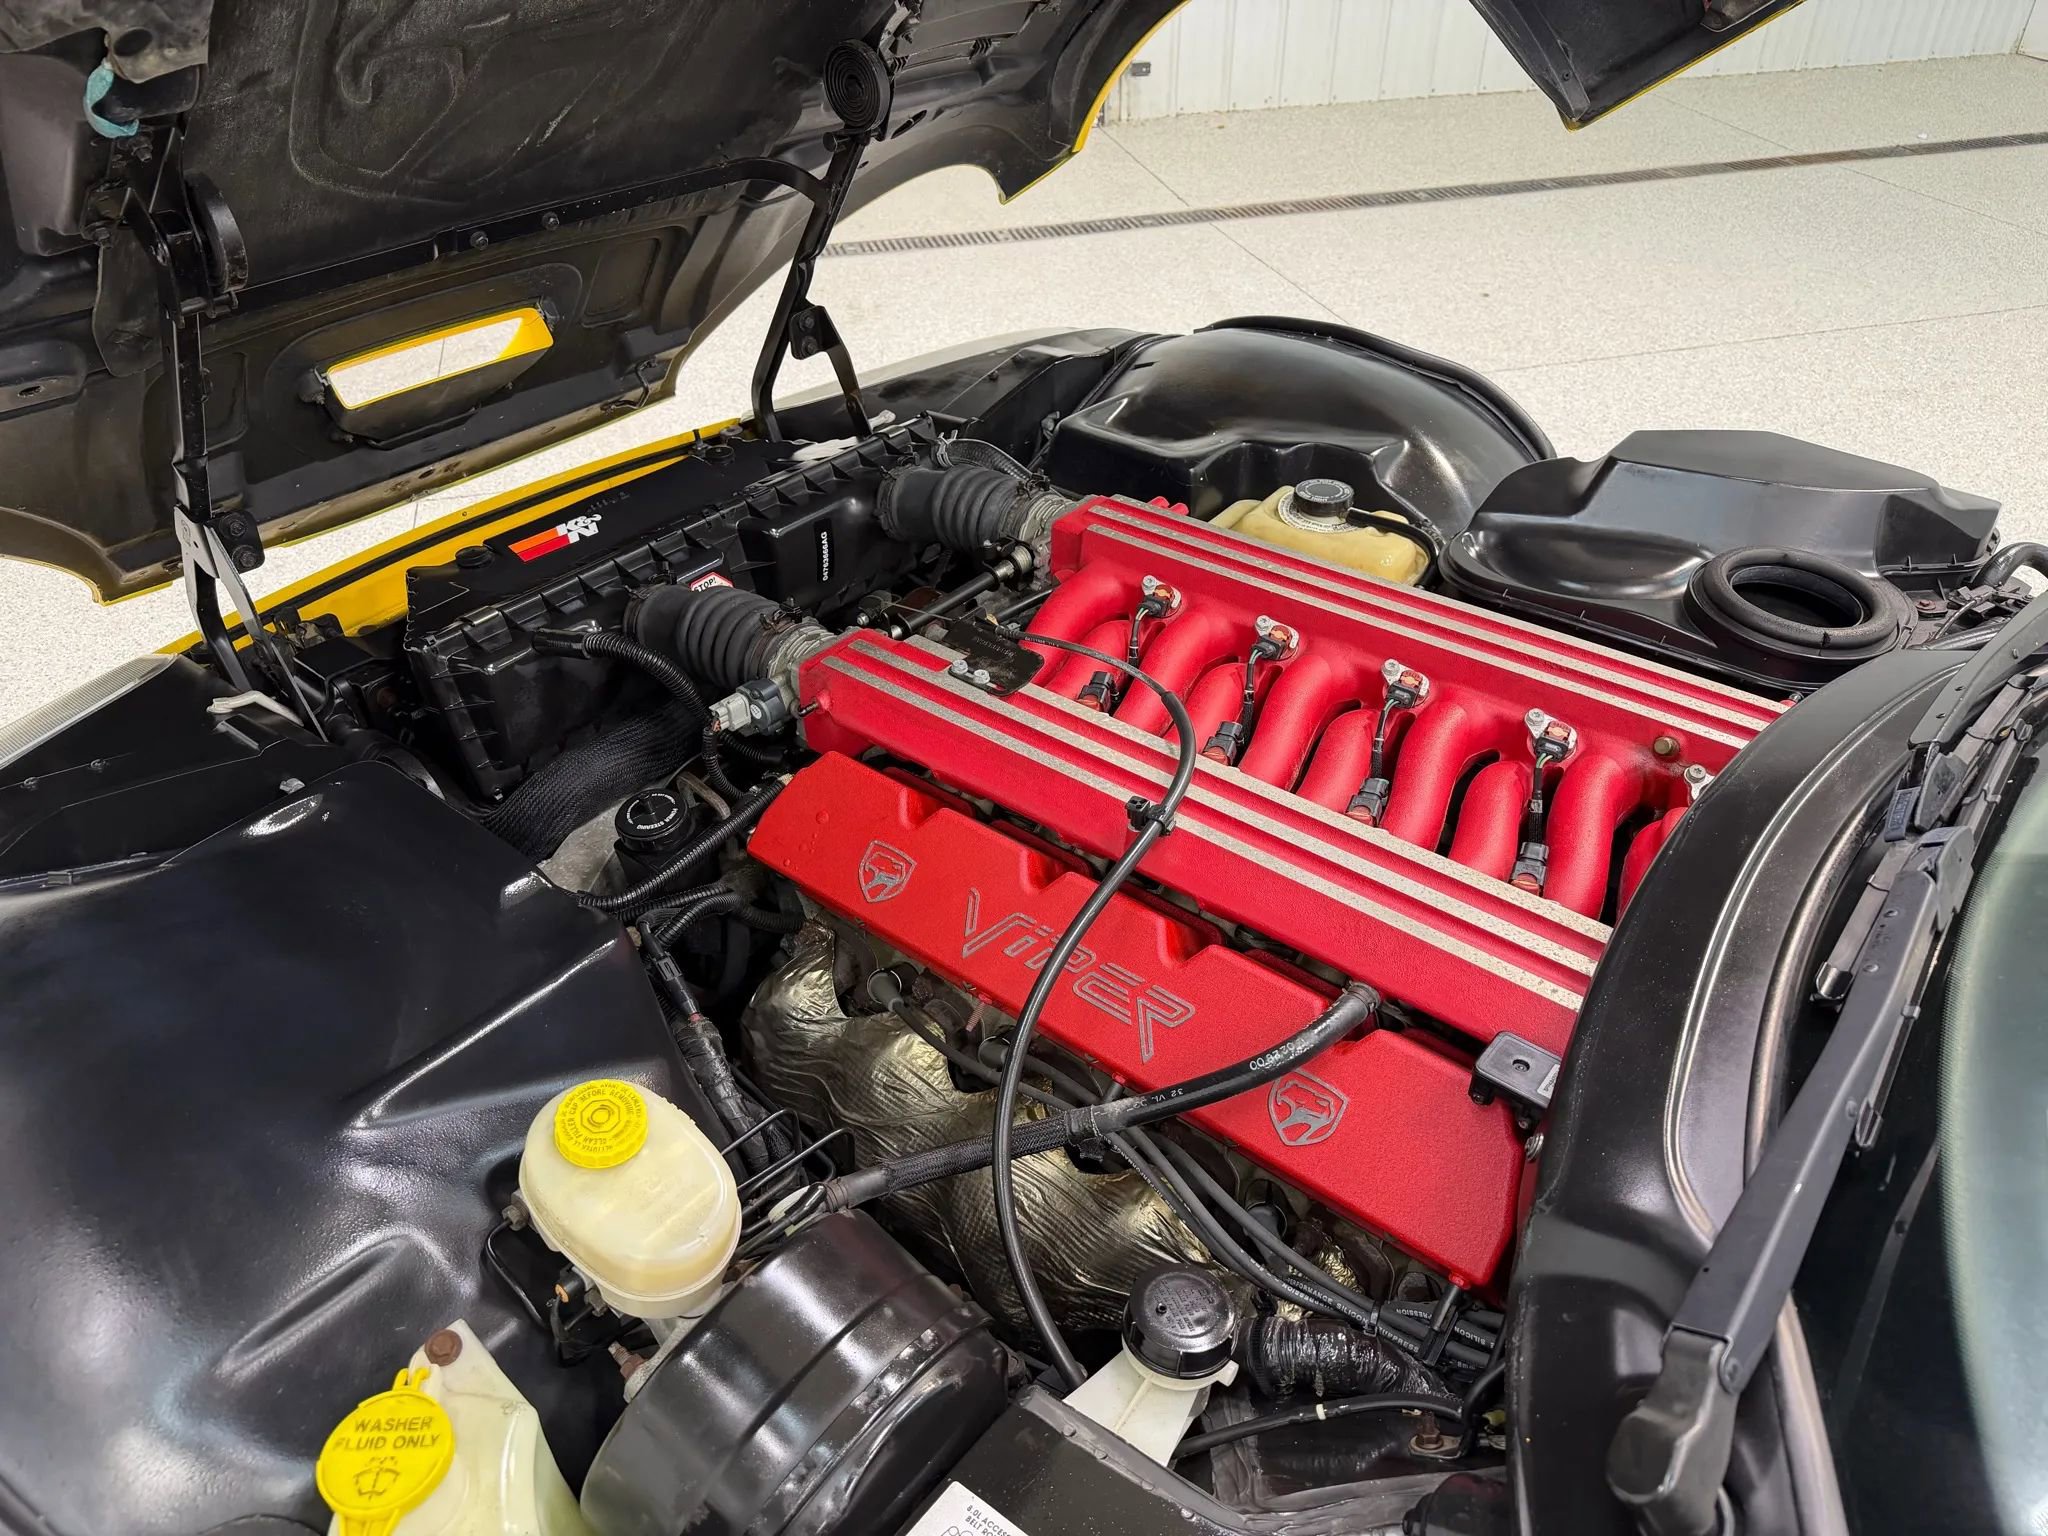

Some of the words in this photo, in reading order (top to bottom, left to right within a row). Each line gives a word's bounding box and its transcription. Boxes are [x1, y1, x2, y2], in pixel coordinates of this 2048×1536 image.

[556, 513, 602, 544] K&N
[354, 1415, 433, 1432] WASHER
[332, 1435, 387, 1451] FLUID
[392, 1433, 440, 1449] ONLY
[965, 1515, 982, 1530] BELT
[981, 1517, 1011, 1536] ACCES
